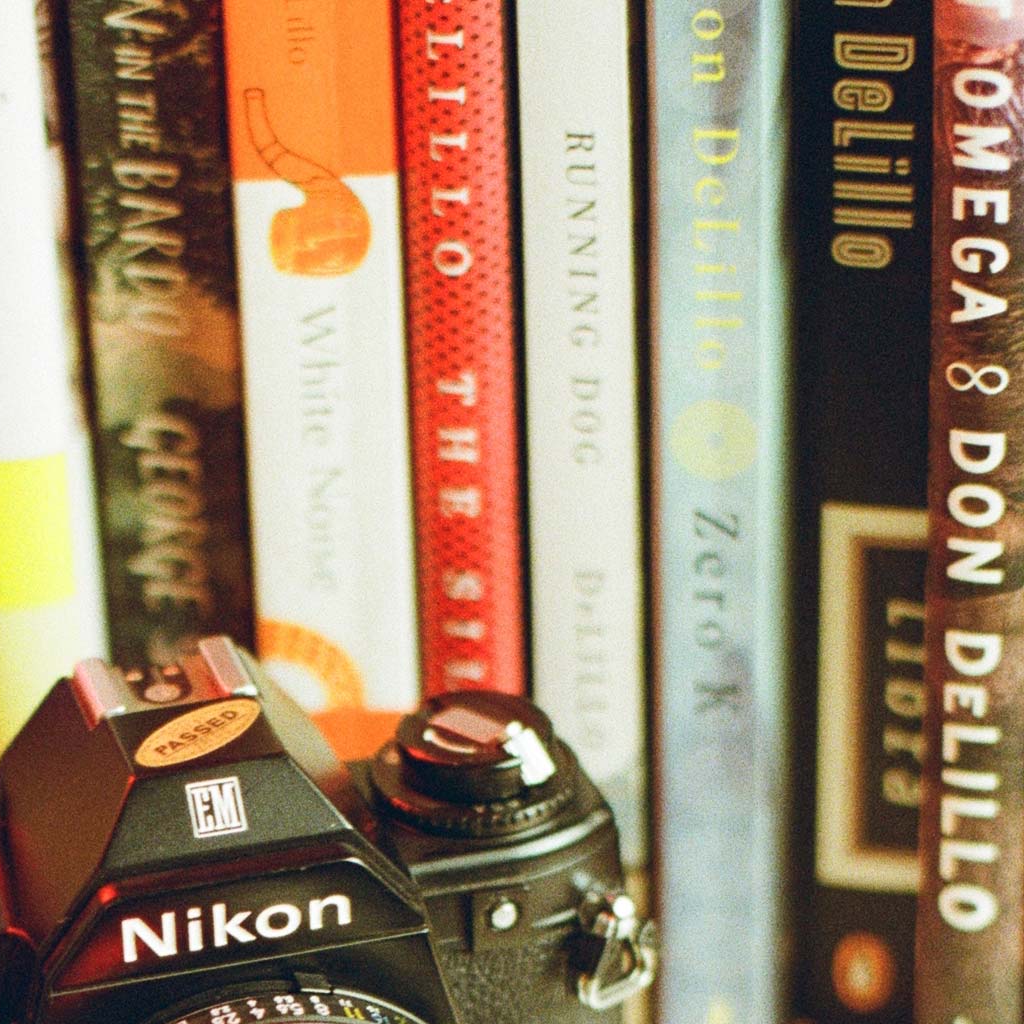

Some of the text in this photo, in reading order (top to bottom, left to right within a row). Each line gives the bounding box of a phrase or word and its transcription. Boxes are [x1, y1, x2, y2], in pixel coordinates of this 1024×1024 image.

[115, 92, 163, 153] THE
[426, 0, 474, 279] LILLO
[831, 33, 917, 270] DeLillo
[950, 68, 1013, 325] OMEGA
[564, 130, 601, 350] RUNNING
[690, 128, 745, 371] DeLillo
[692, 508, 742, 650] Zero
[944, 429, 1008, 585] DON
[154, 709, 239, 756] PASSED
[188, 779, 244, 836] EM
[937, 628, 1003, 932] DELILLO
[121, 893, 353, 964] Nikon
